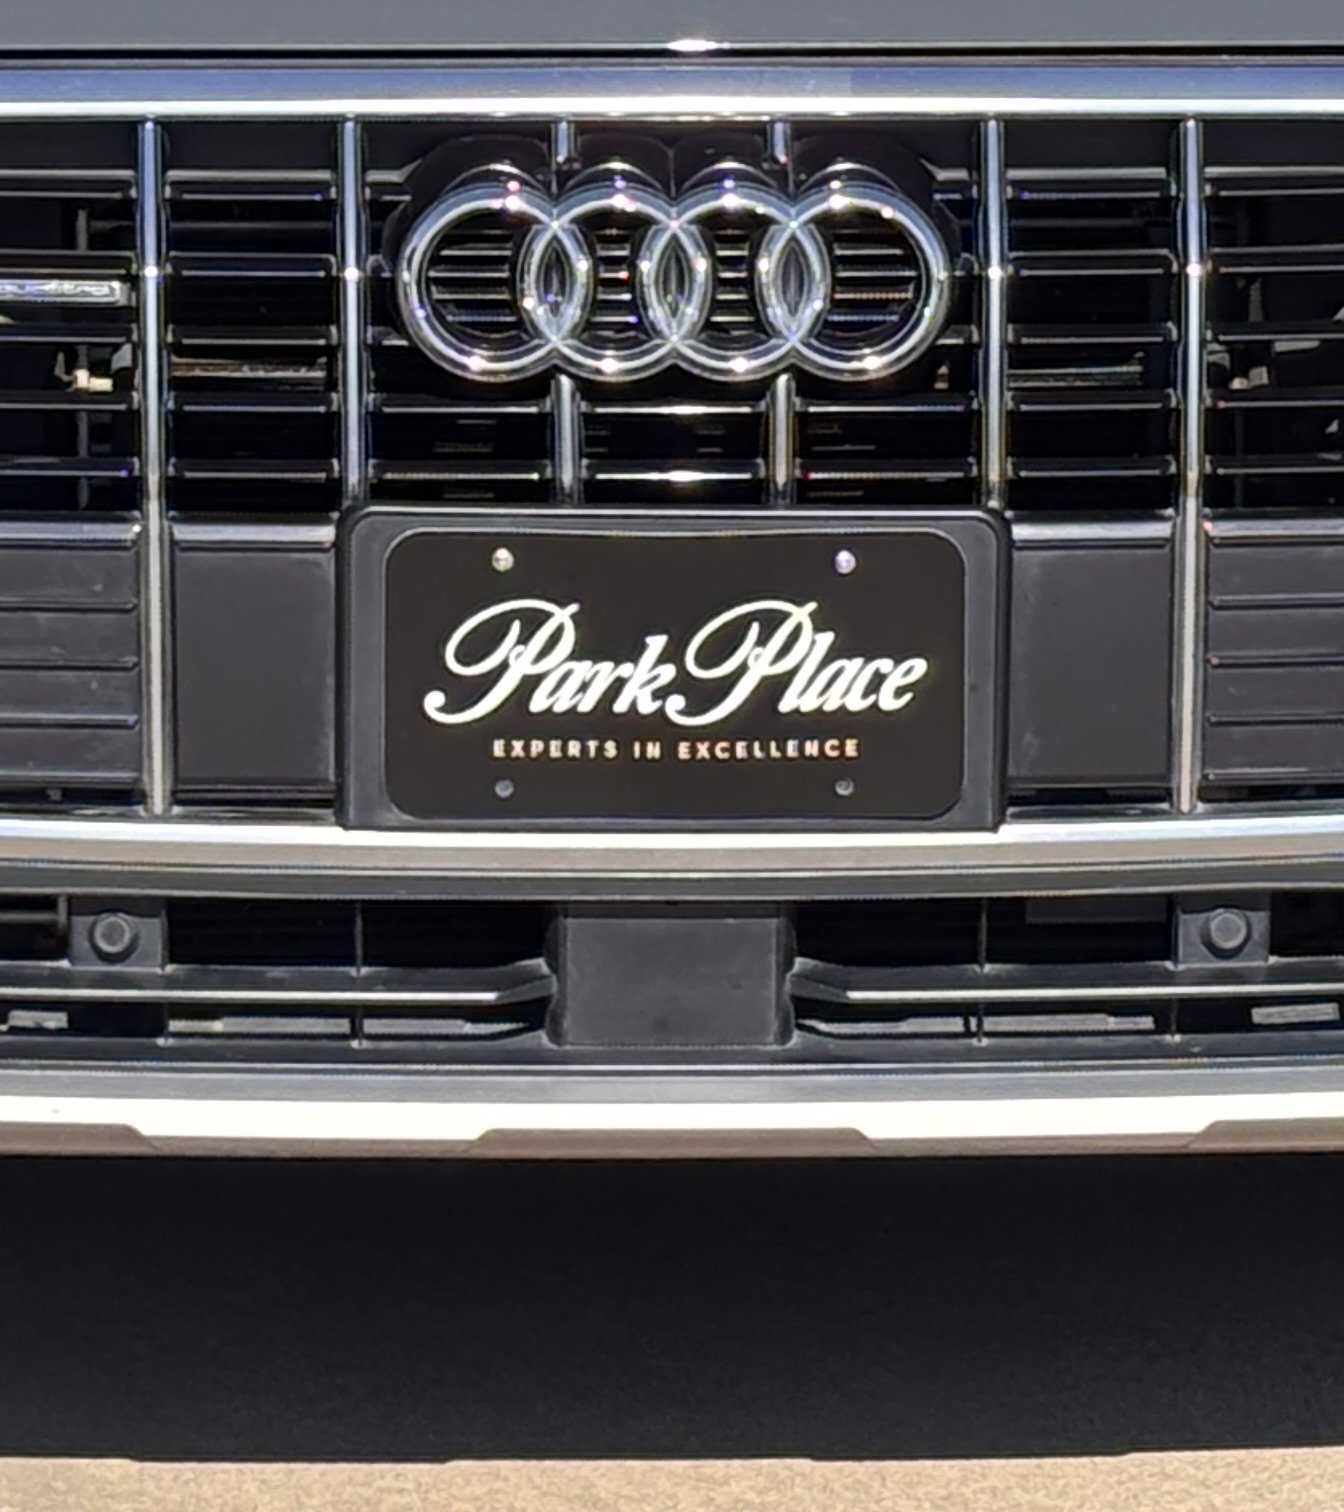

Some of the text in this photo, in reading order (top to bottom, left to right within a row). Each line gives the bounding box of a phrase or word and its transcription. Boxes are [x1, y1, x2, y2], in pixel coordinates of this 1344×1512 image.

[423, 598, 929, 727] Park Place
[492, 738, 859, 760] EXPERTS IN EXCELLENCE
